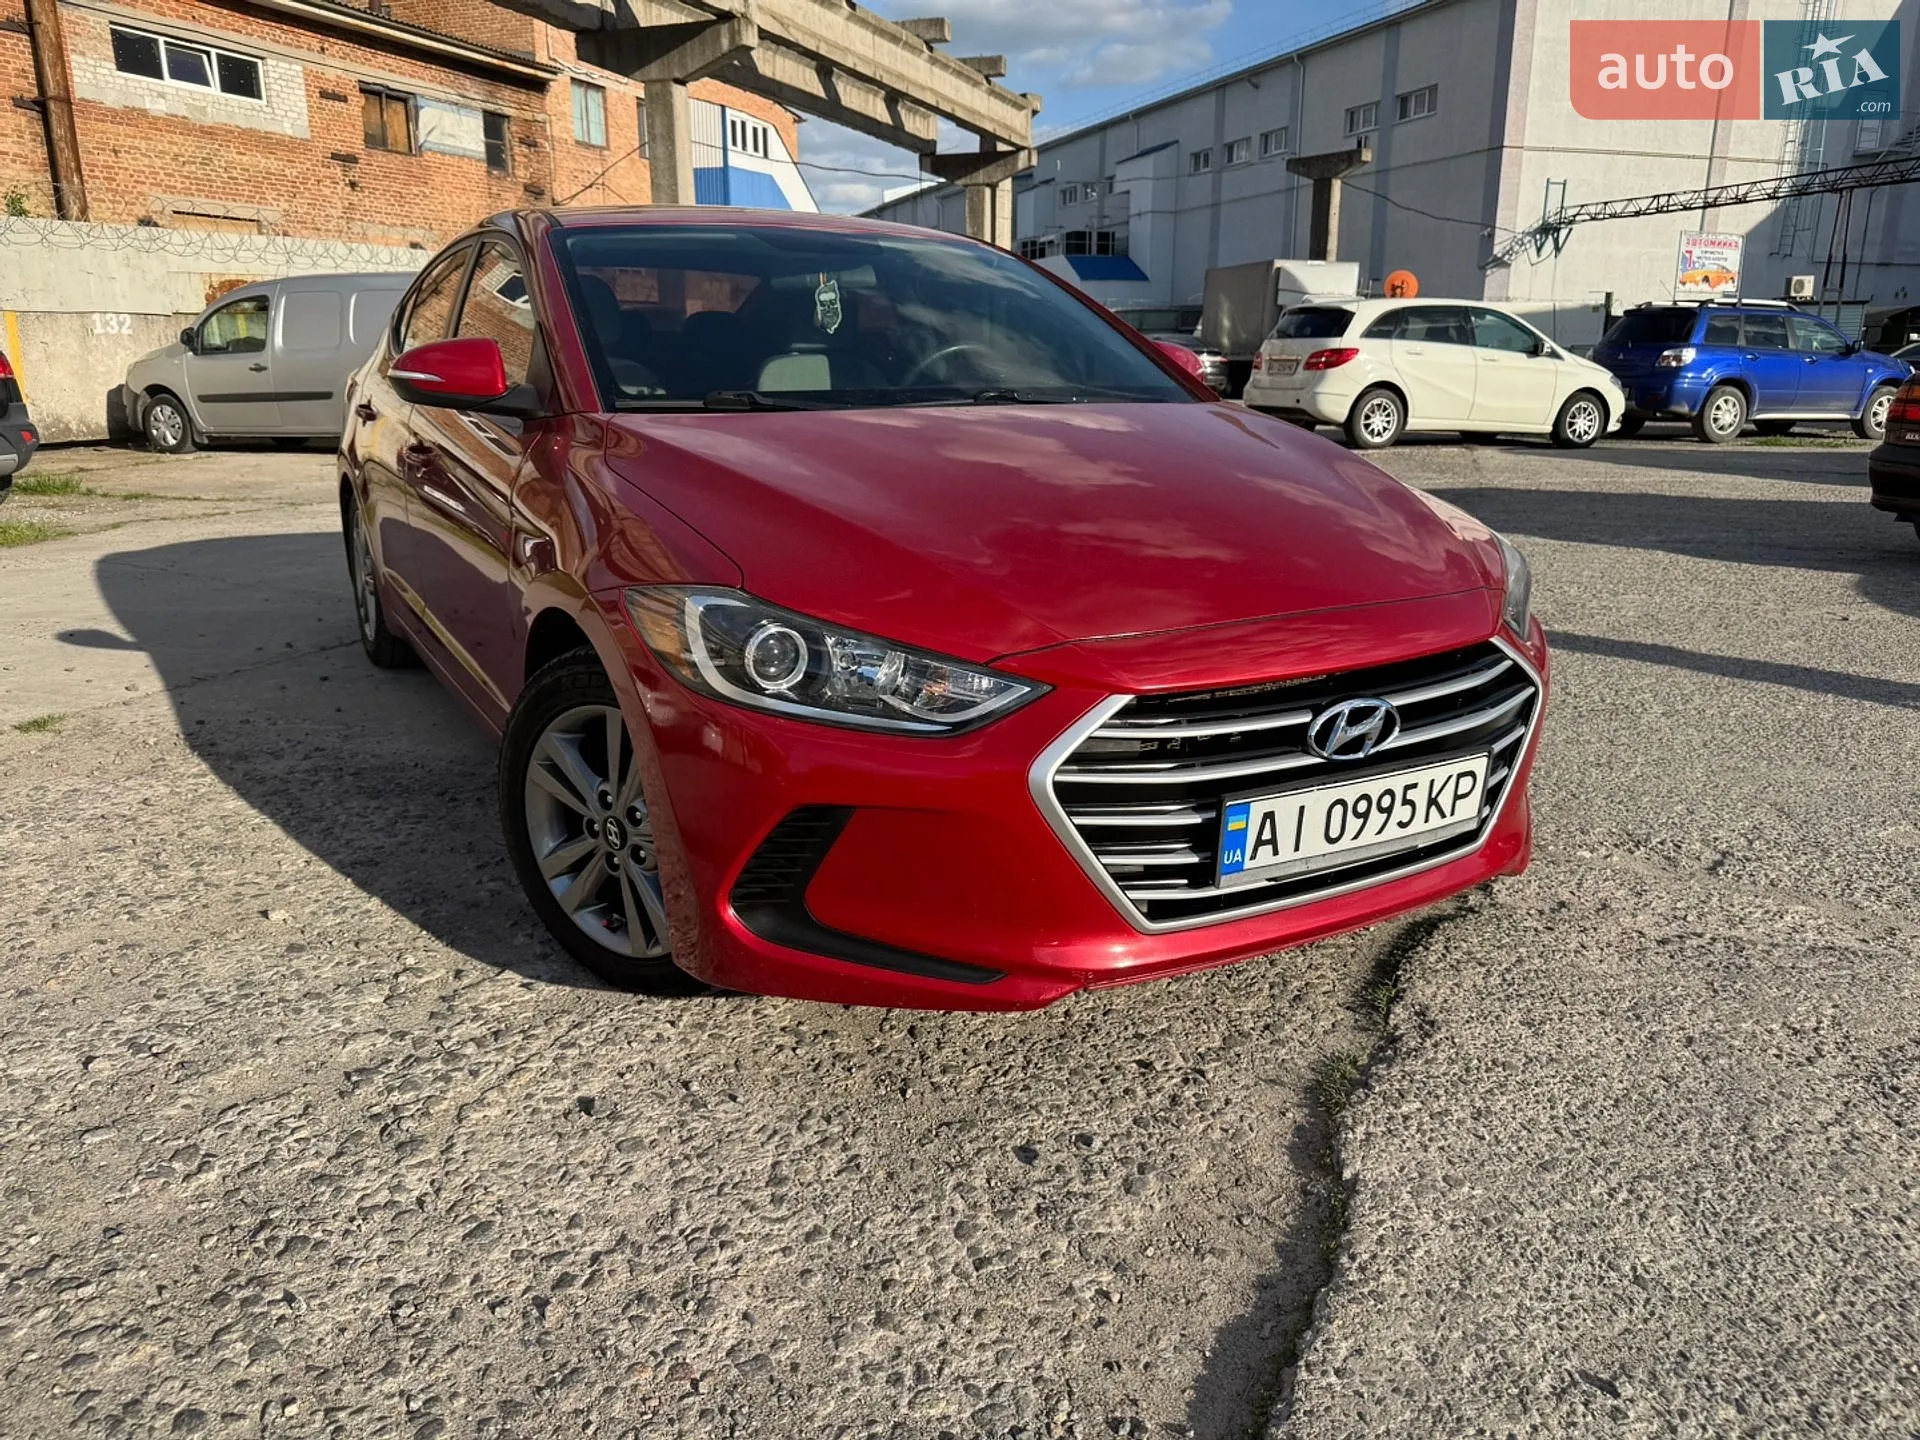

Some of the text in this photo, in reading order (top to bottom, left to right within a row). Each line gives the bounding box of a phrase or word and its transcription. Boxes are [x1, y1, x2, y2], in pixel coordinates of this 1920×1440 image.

[91, 312, 133, 335] 132
[1249, 804, 1305, 861] AI
[1223, 847, 1243, 865] UA
